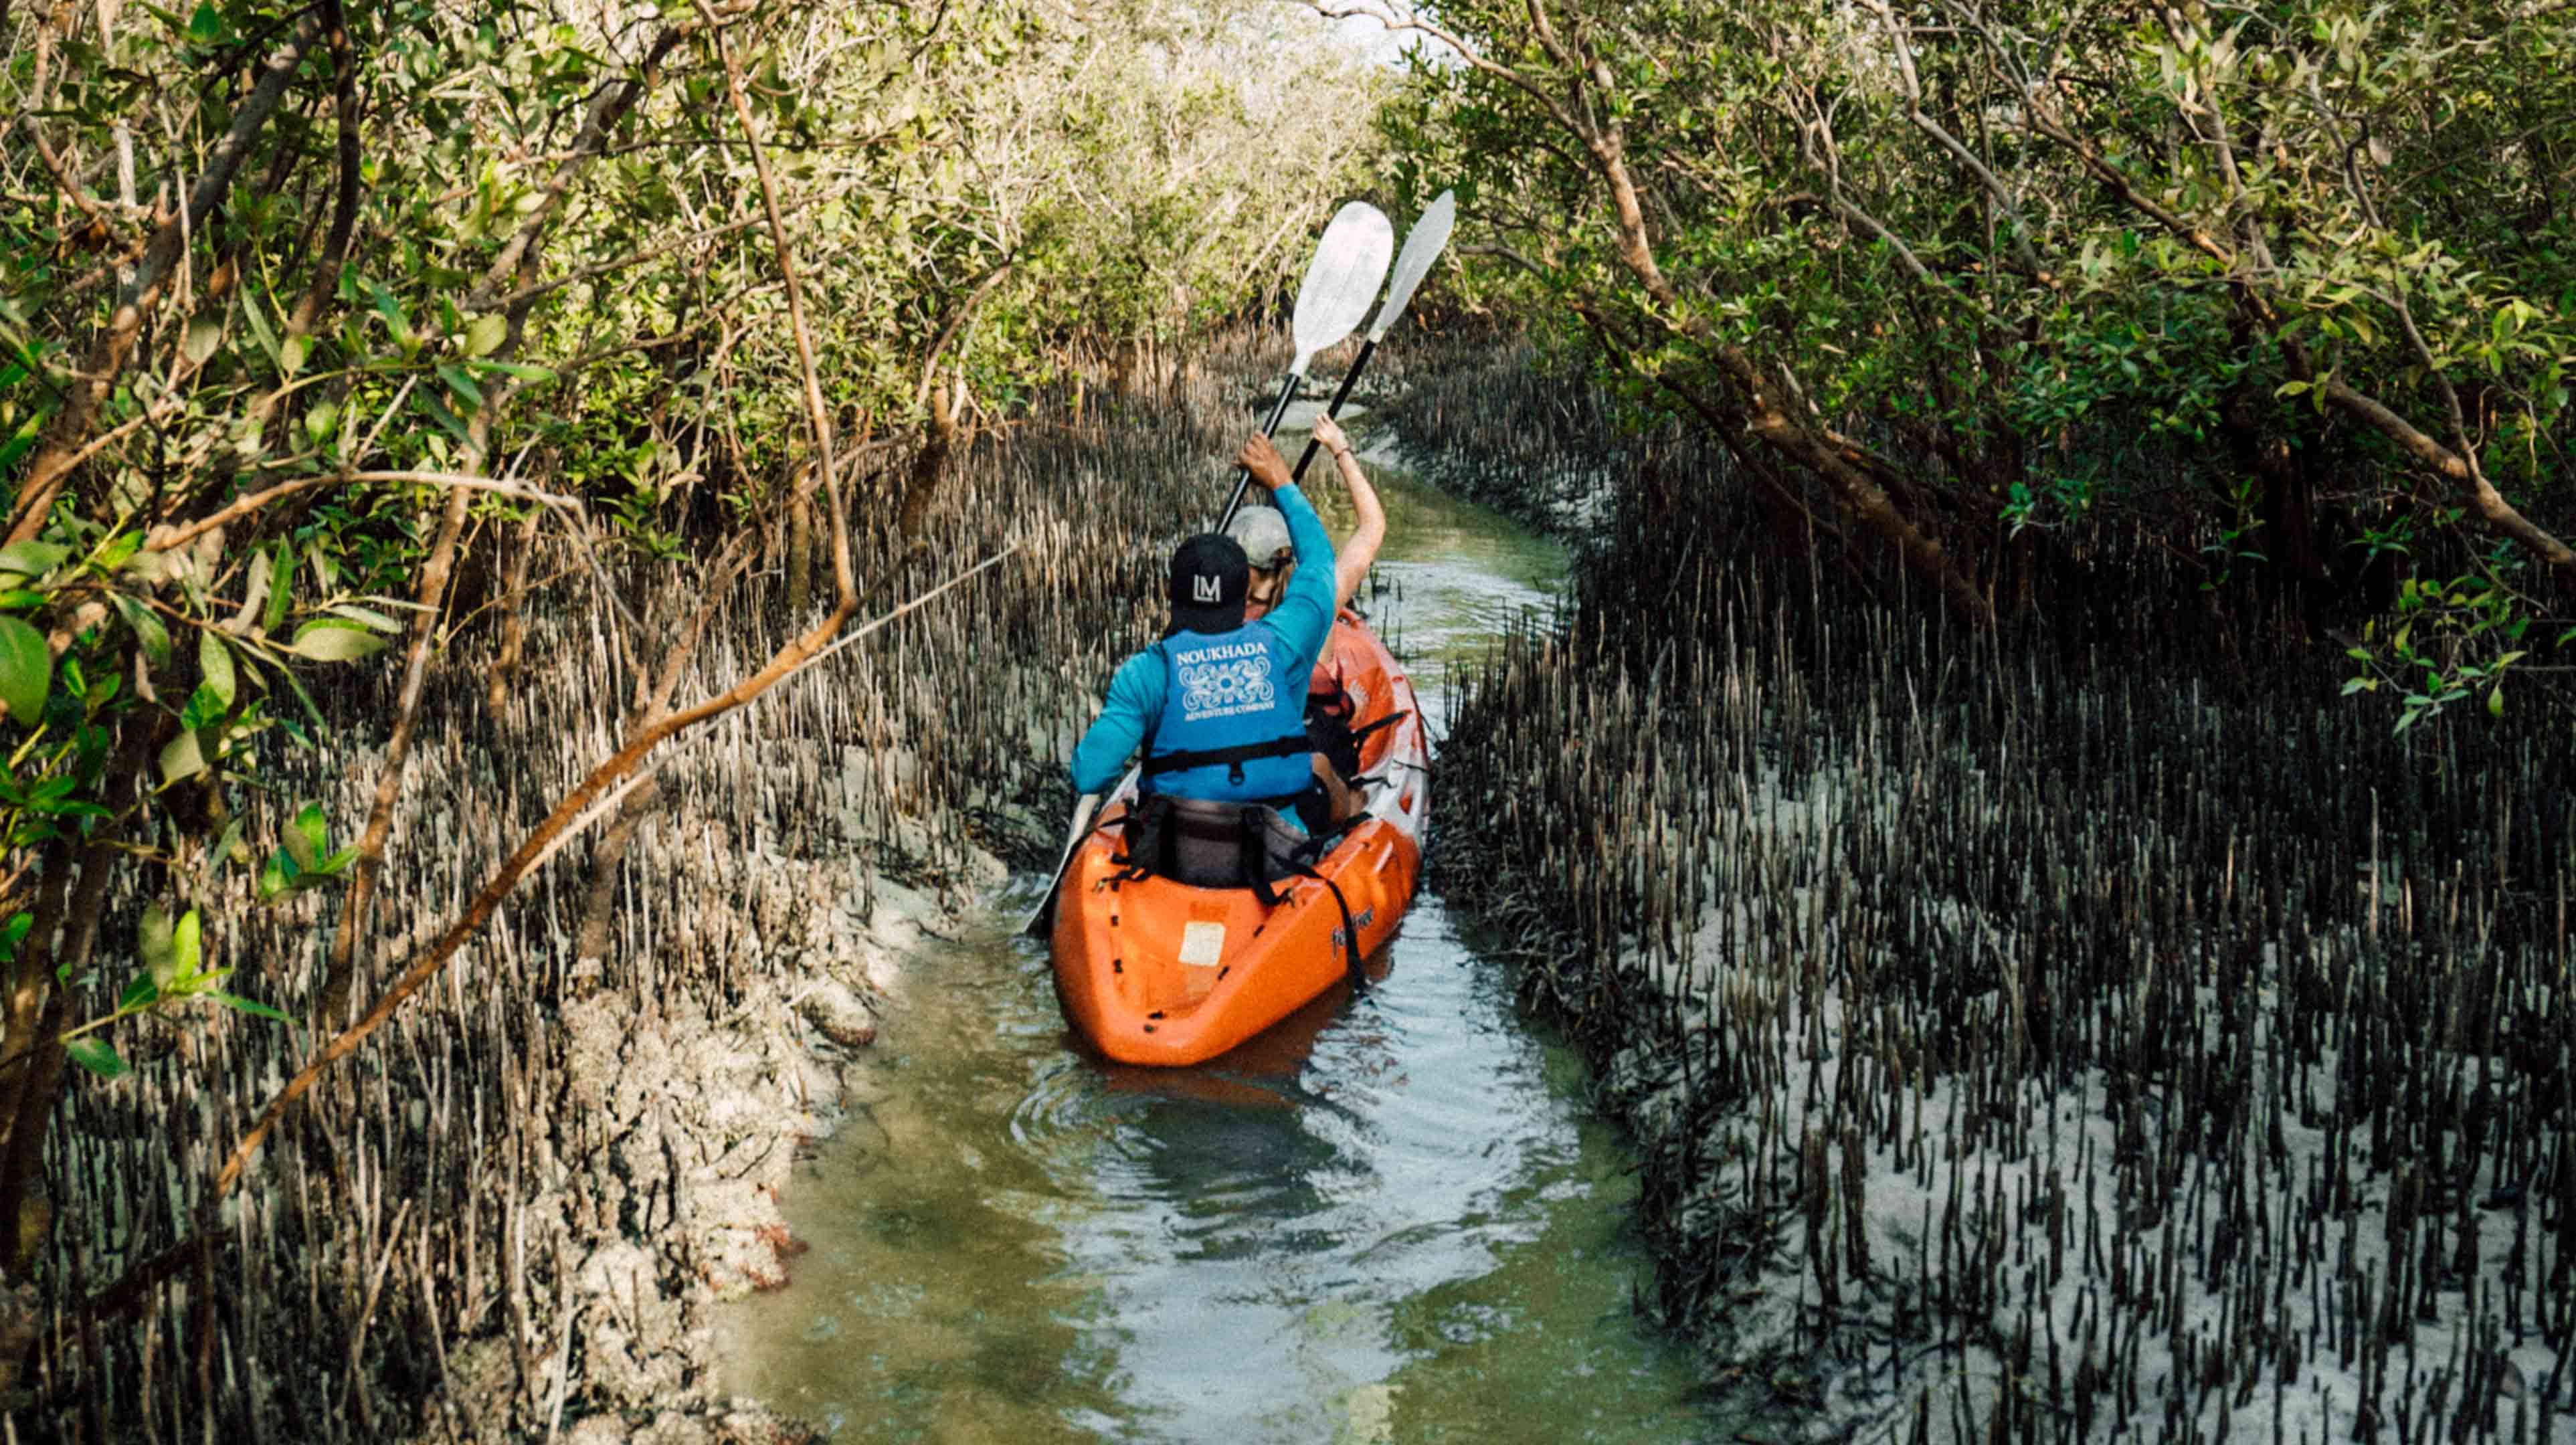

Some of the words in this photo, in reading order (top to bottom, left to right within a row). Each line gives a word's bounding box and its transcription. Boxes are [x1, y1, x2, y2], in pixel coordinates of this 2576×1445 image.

[1194, 574, 1220, 602] LM
[1176, 642, 1267, 665] NOUKHADA
[1184, 706, 1234, 721] ADVENTURE
[1235, 700, 1275, 714] COMPANY
